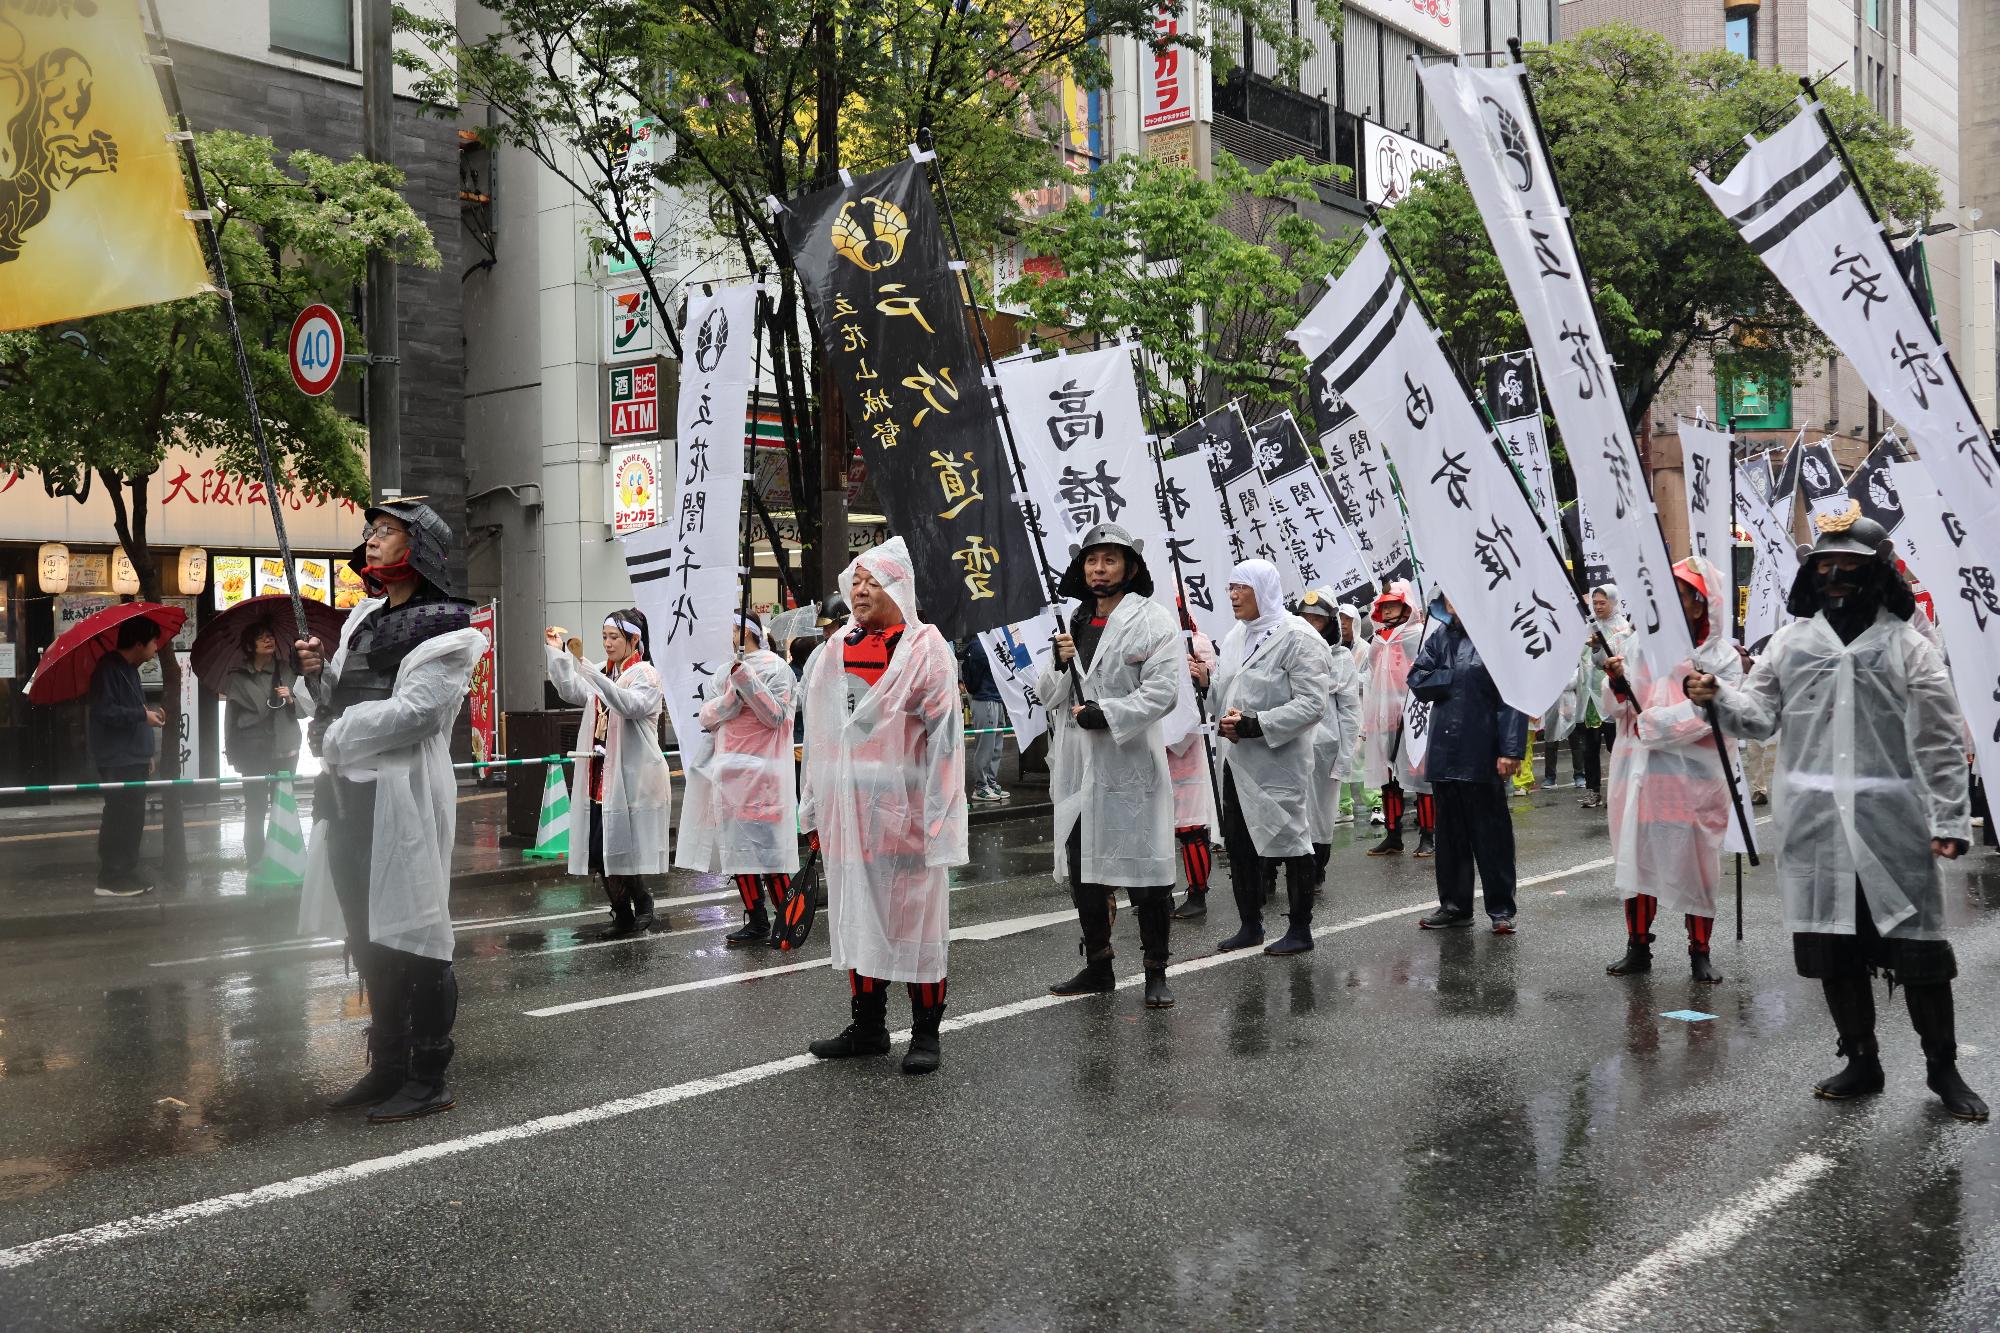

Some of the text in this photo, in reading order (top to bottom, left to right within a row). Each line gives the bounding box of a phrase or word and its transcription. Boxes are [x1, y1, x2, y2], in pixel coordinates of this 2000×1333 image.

[1154, 0, 1179, 110] ンカラ
[301, 329, 330, 370] 40
[615, 375, 628, 396] 酒
[634, 373, 656, 393] たばこ
[615, 403, 654, 431] ATM
[616, 509, 655, 523] ジャンカラ
